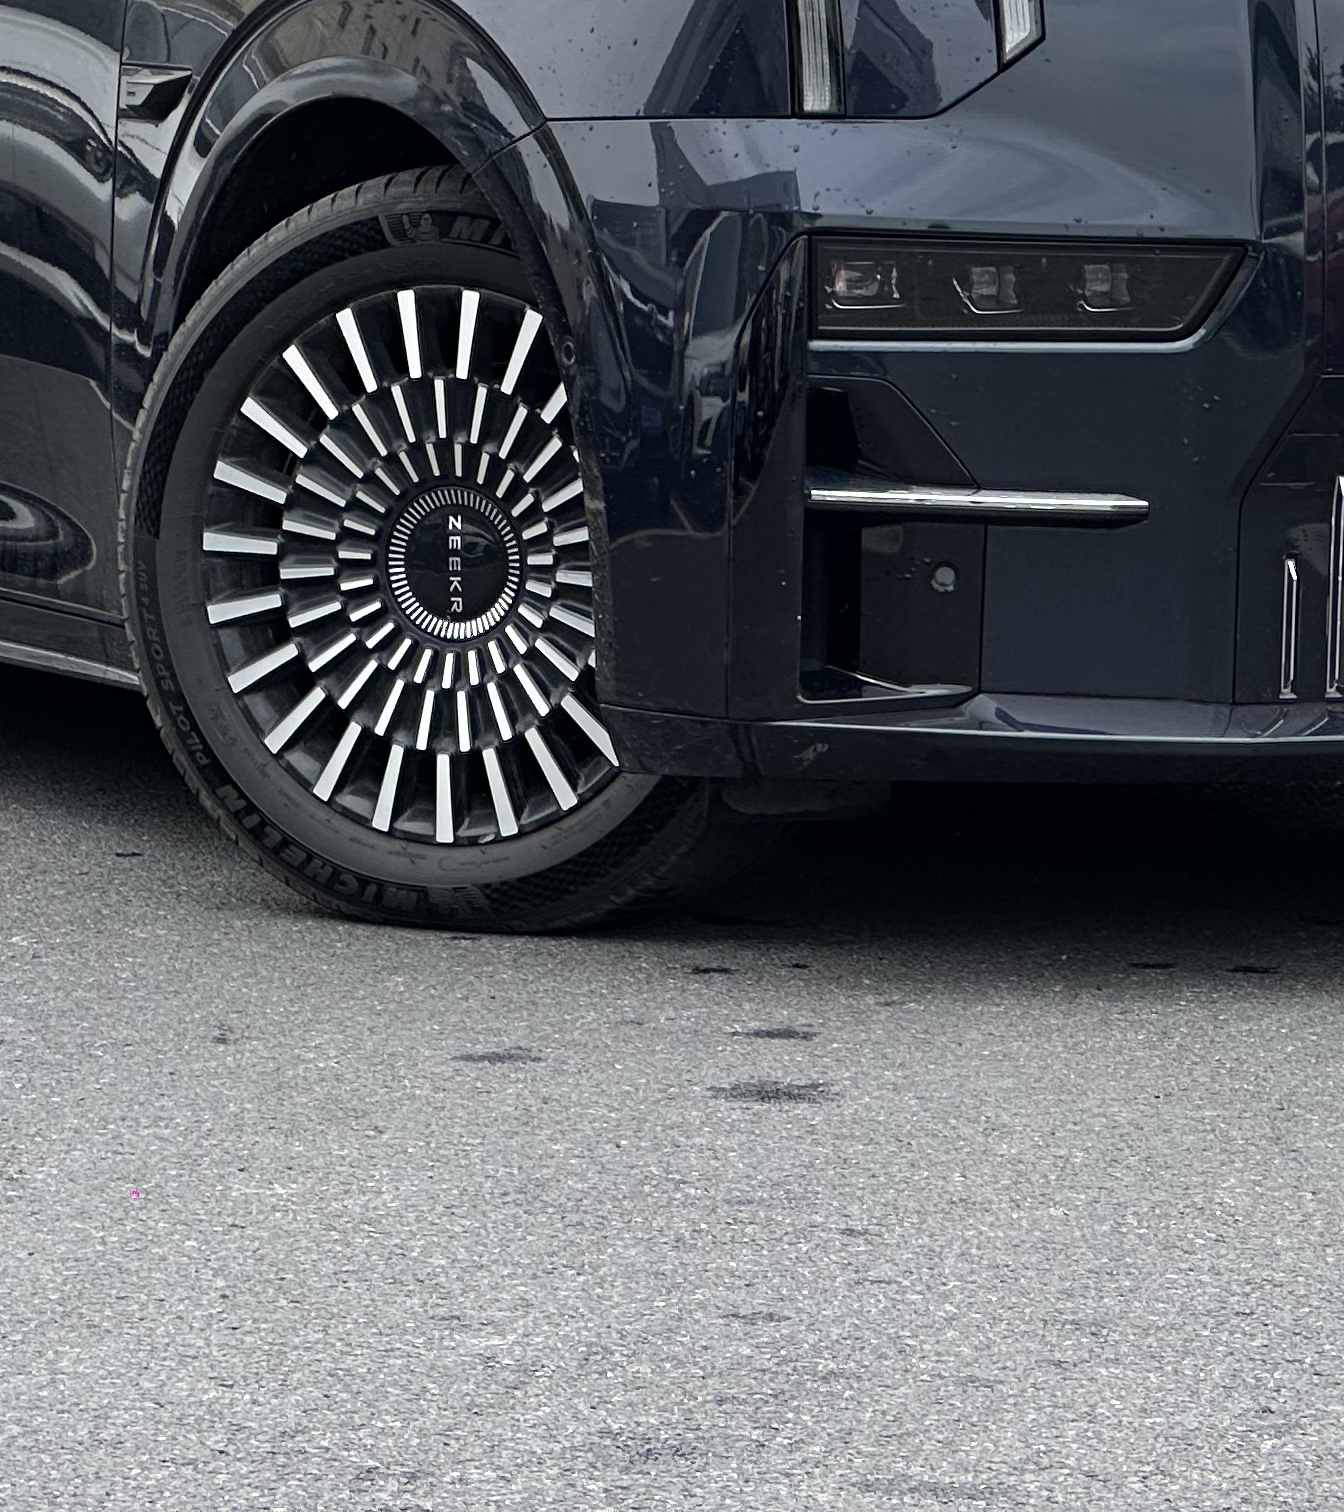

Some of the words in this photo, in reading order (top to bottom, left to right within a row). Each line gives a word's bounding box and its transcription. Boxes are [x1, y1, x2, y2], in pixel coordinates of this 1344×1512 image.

[447, 514, 463, 613] ZEEKR
[143, 609, 175, 692] SPORT
[167, 702, 213, 767] PILOT
[215, 784, 419, 910] MICHELIN
